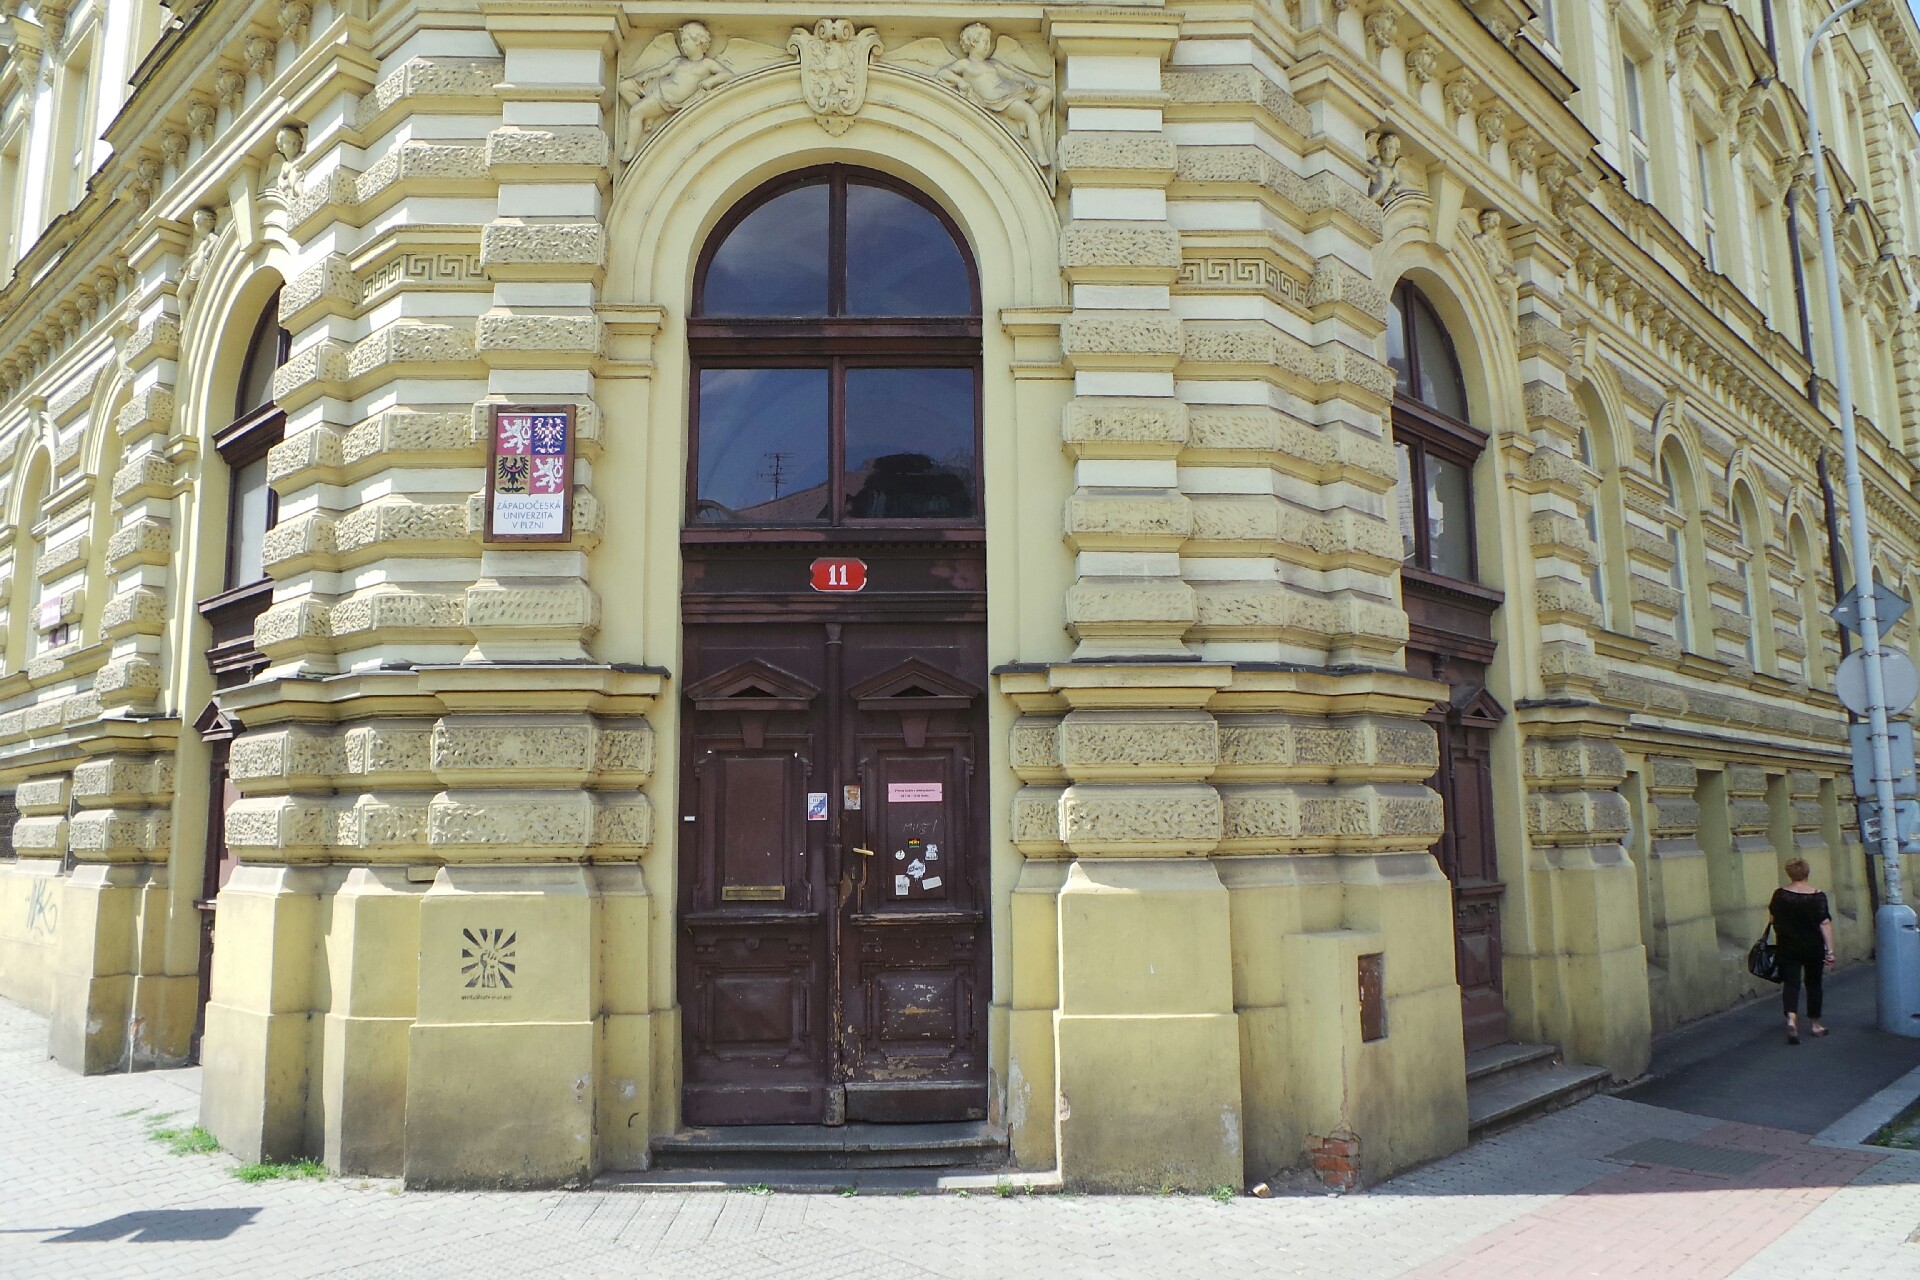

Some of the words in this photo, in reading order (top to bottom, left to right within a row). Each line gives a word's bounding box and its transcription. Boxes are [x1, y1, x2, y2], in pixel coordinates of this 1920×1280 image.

[496, 500, 561, 510] ZÁPADOČESKÁ
[503, 511, 554, 520] UNIVERZITA
[512, 521, 519, 529] V
[520, 521, 544, 529] PLZNI
[828, 564, 849, 586] 11
